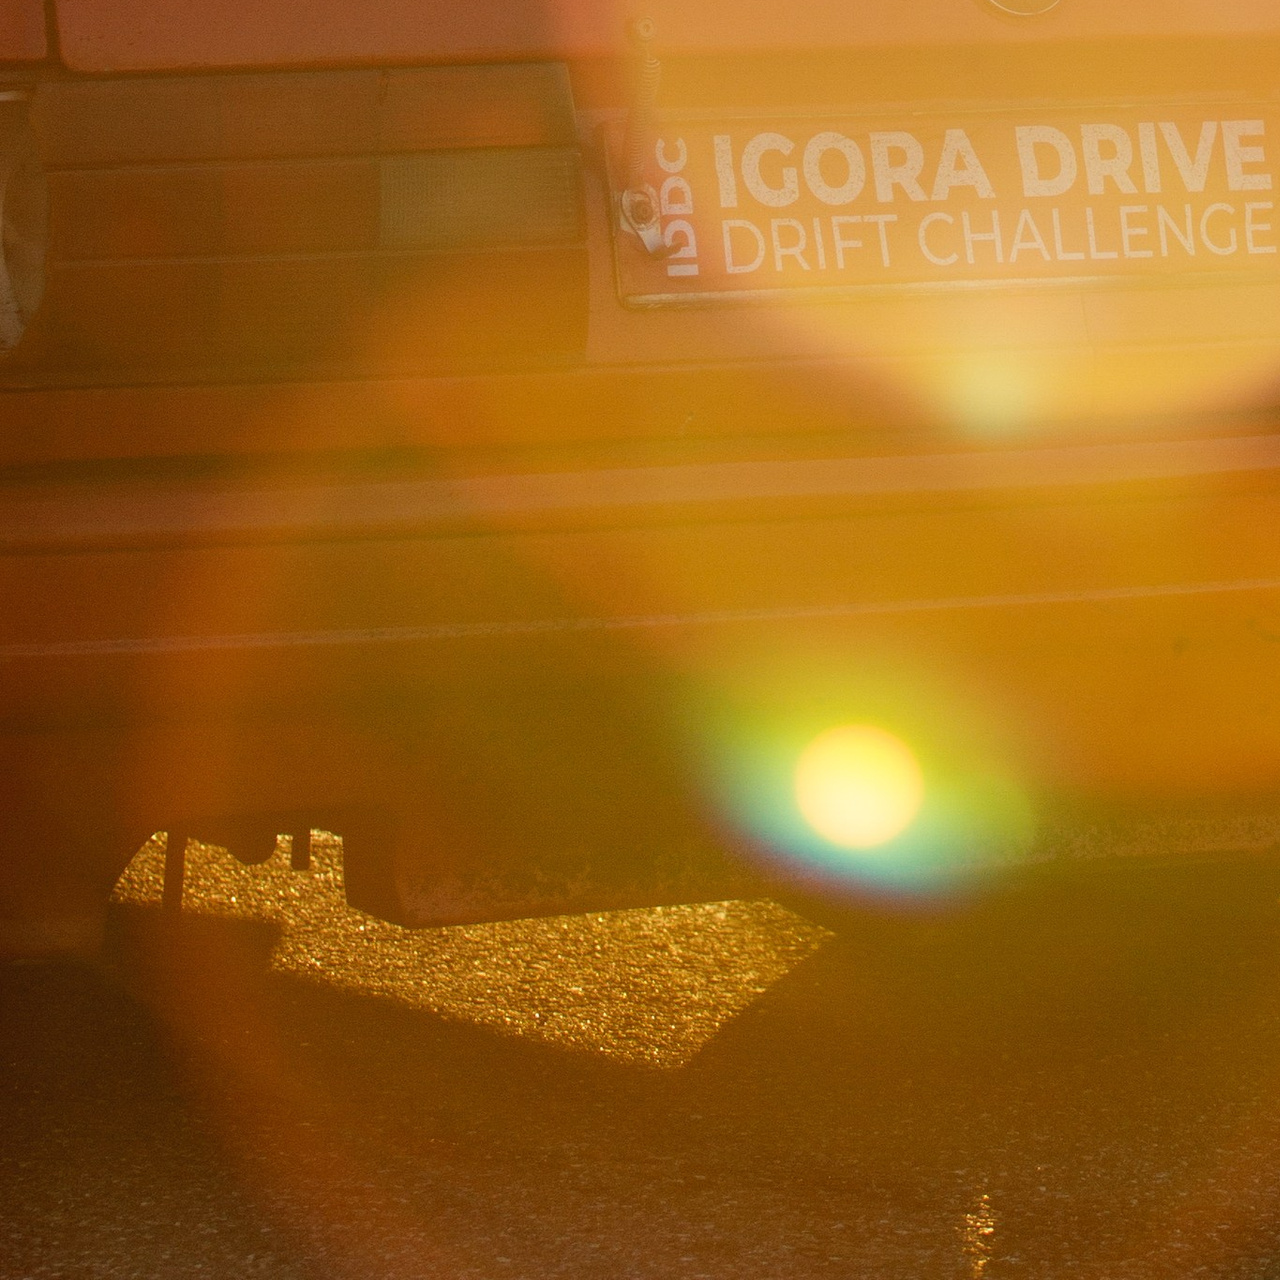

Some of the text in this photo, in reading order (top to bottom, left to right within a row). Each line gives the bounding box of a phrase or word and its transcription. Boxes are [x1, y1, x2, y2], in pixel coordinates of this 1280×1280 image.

[711, 119, 1273, 208] IGORA DRIVE
[721, 200, 1278, 276] DRIFT CHALLENGE
